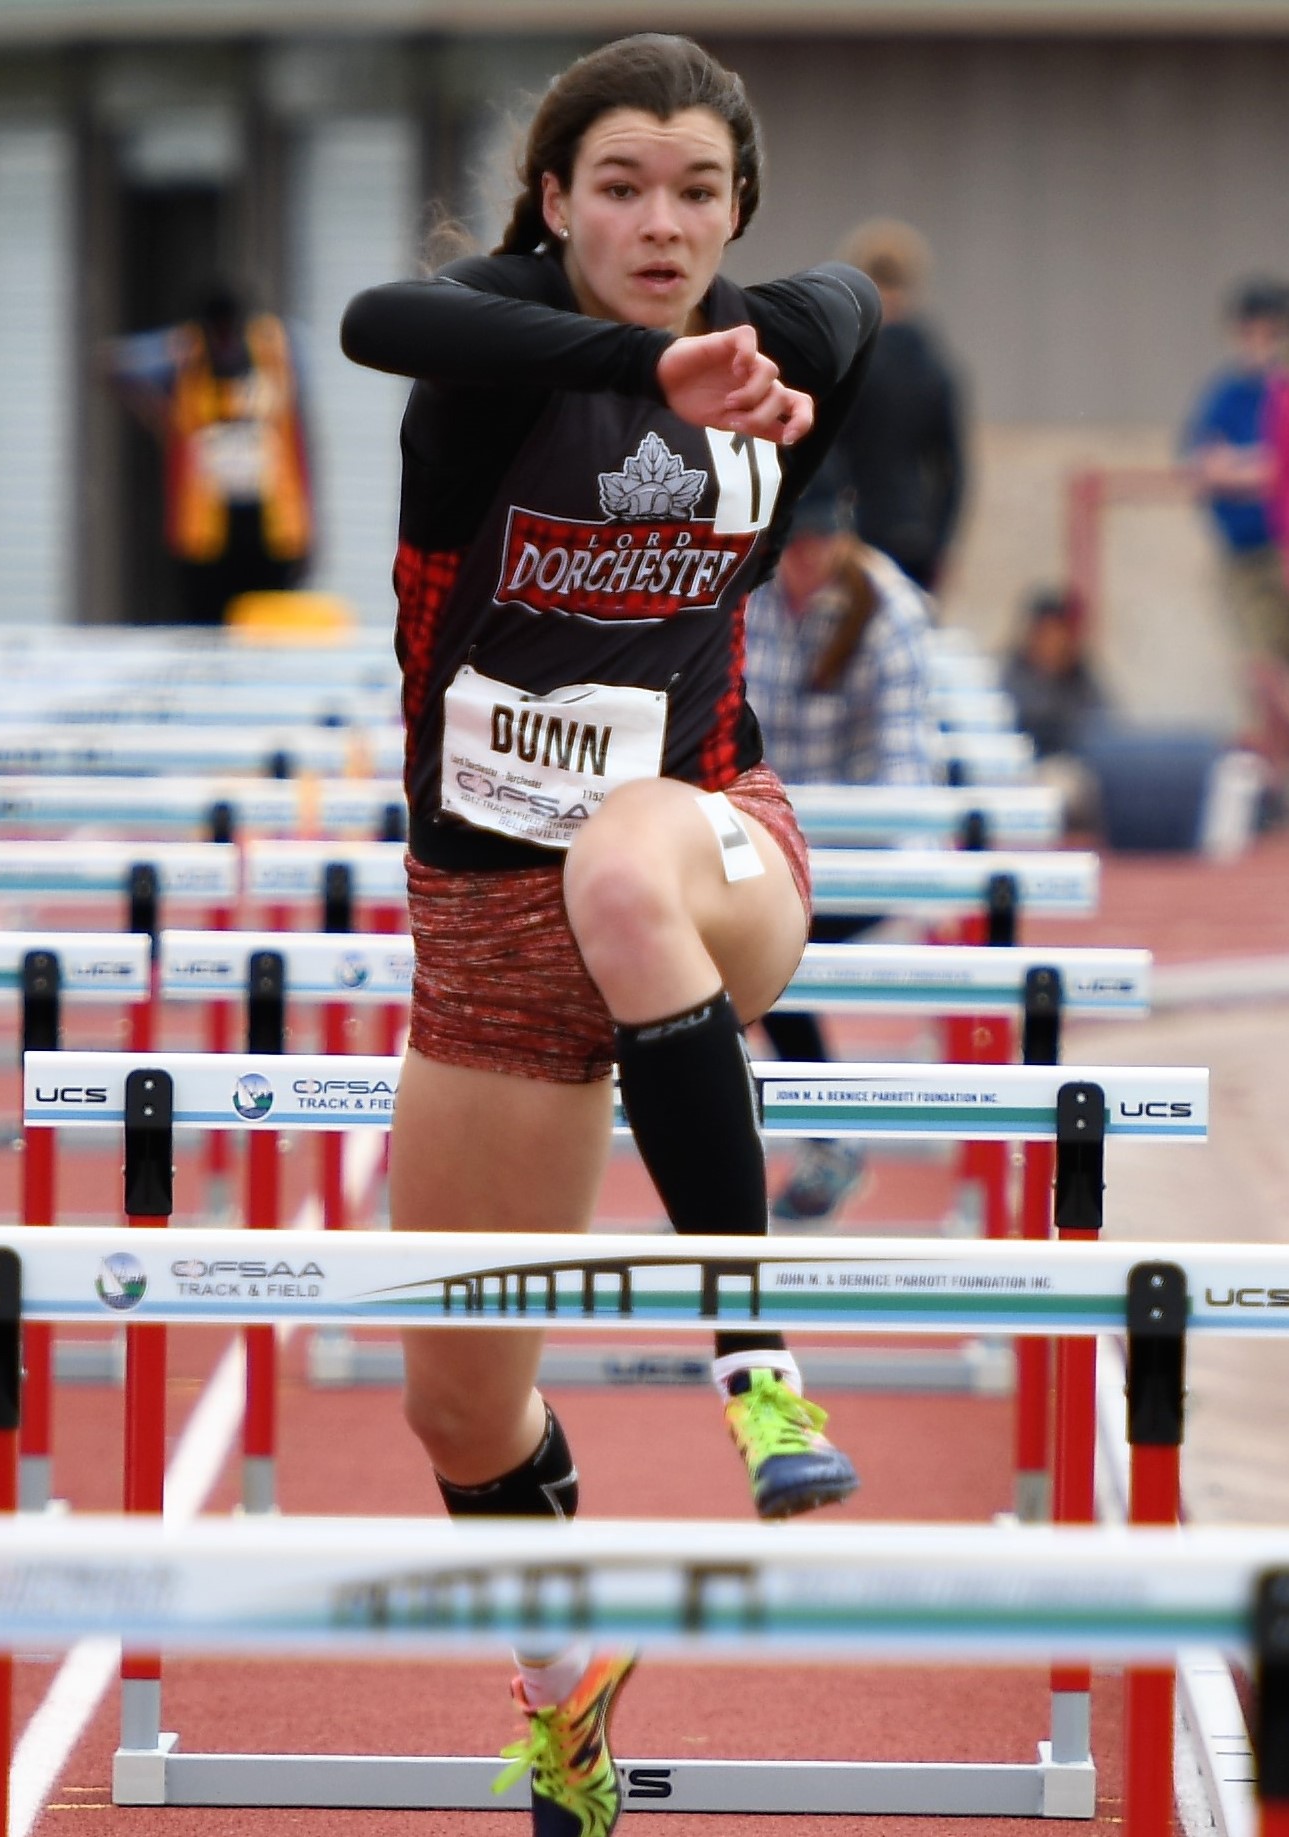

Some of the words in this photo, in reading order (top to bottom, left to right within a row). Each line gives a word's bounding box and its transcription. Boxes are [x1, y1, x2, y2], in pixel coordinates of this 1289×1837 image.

[588, 531, 693, 549] LORD
[489, 703, 613, 777] DUNN
[456, 771, 590, 820] OFSA
[293, 1079, 398, 1094] OFSA
[35, 1087, 108, 1103] UCS
[298, 1097, 349, 1109] TRACK
[354, 1098, 364, 1109] &
[1120, 1101, 1192, 1117] UCS
[170, 1260, 326, 1279] OFSAA
[839, 1274, 891, 1288] BERNICE
[895, 1274, 947, 1288] PARROTT
[952, 1275, 1027, 1289] FOUNDATION
[177, 1282, 241, 1297] TRACK
[248, 1284, 261, 1297] &
[267, 1283, 321, 1298] FIELD
[1204, 1287, 1289, 1308] UCS
